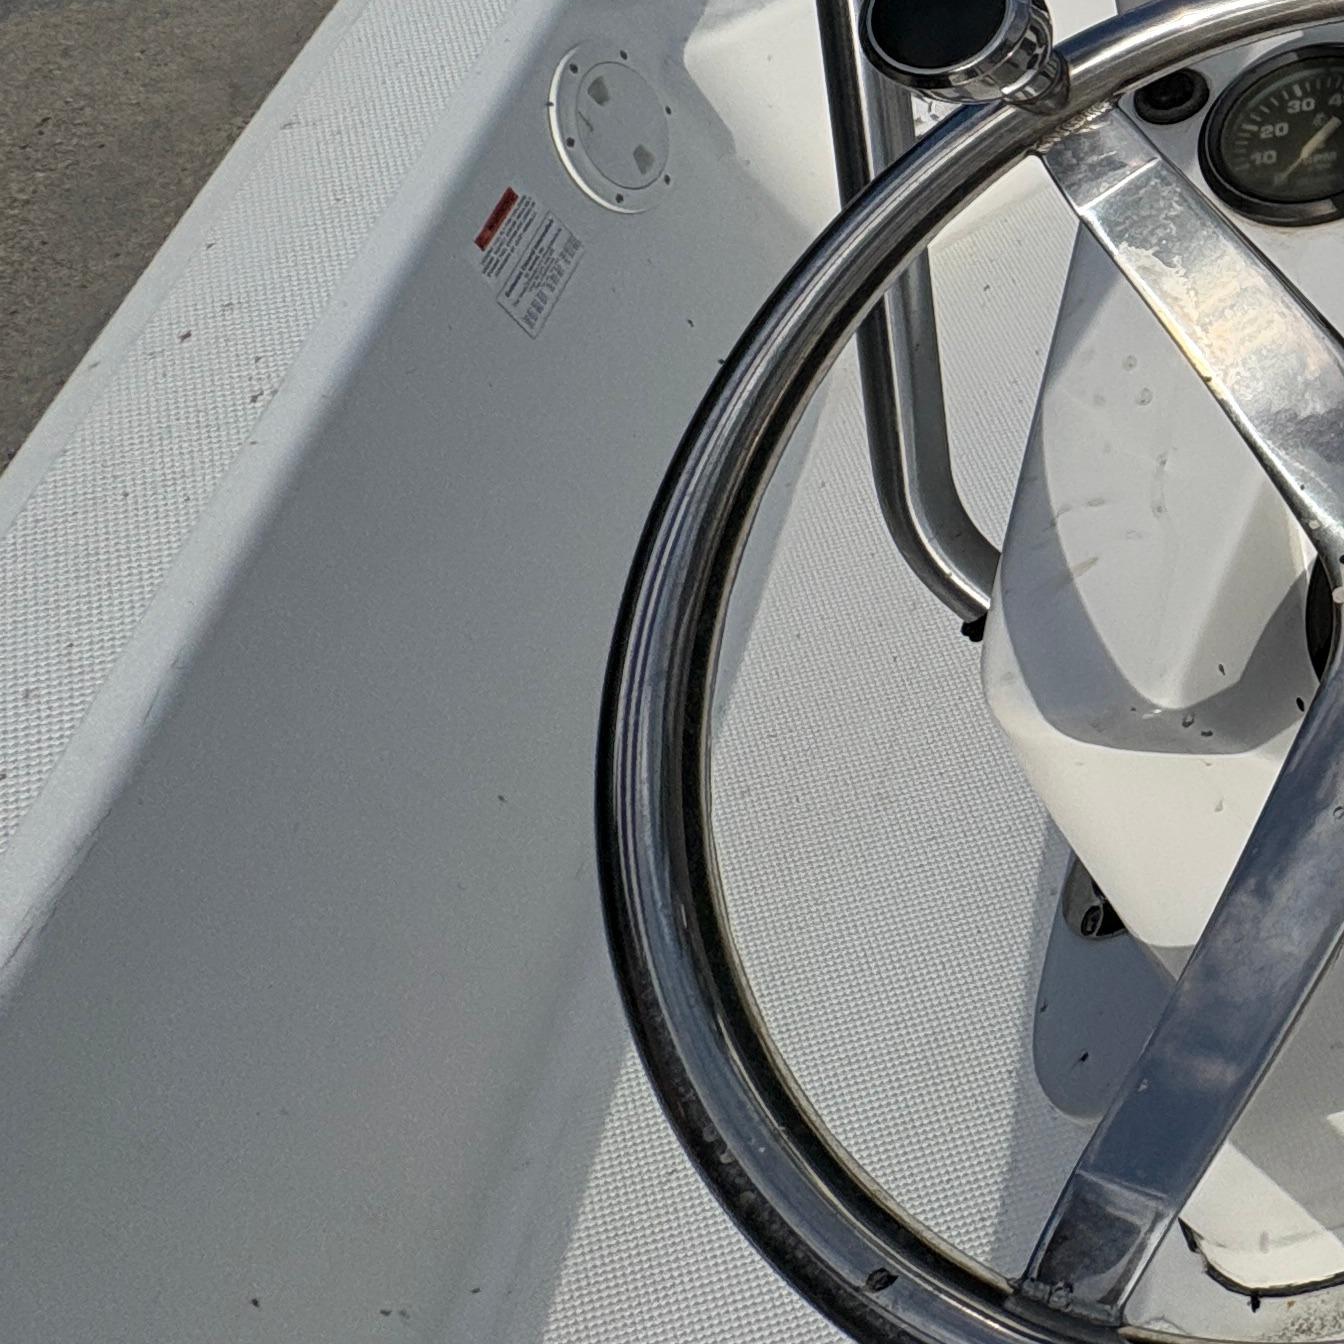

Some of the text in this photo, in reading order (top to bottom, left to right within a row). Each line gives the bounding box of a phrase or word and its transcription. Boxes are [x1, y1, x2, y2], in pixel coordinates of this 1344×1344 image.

[1287, 98, 1315, 114] 30
[1260, 122, 1289, 139] 20
[1252, 150, 1277, 165] 10
